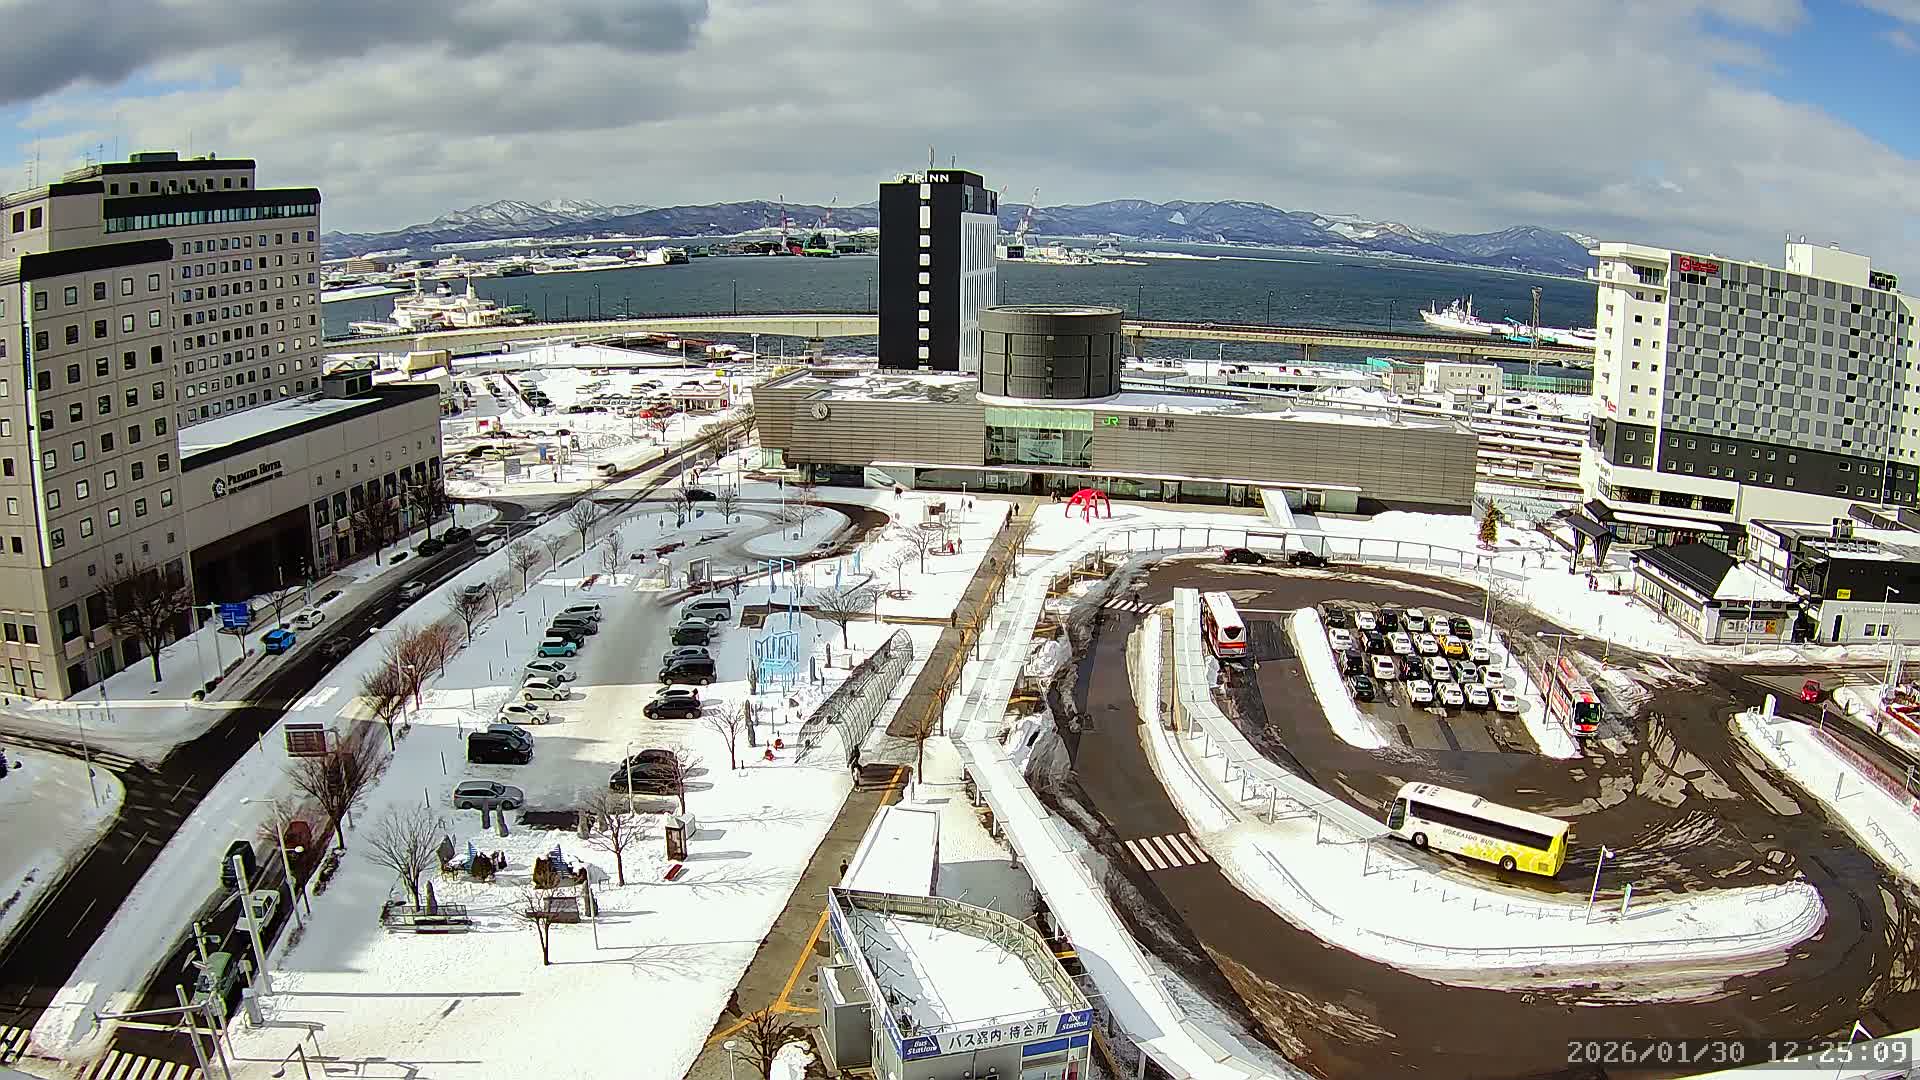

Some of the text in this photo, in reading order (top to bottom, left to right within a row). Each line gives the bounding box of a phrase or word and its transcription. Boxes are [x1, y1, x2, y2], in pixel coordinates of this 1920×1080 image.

[1103, 416, 1120, 426] JR
[259, 460, 282, 475] HOTEL
[1442, 827, 1478, 841] HOKKAIDO
[913, 1040, 928, 1048] Bus
[906, 1046, 938, 1056] Station
